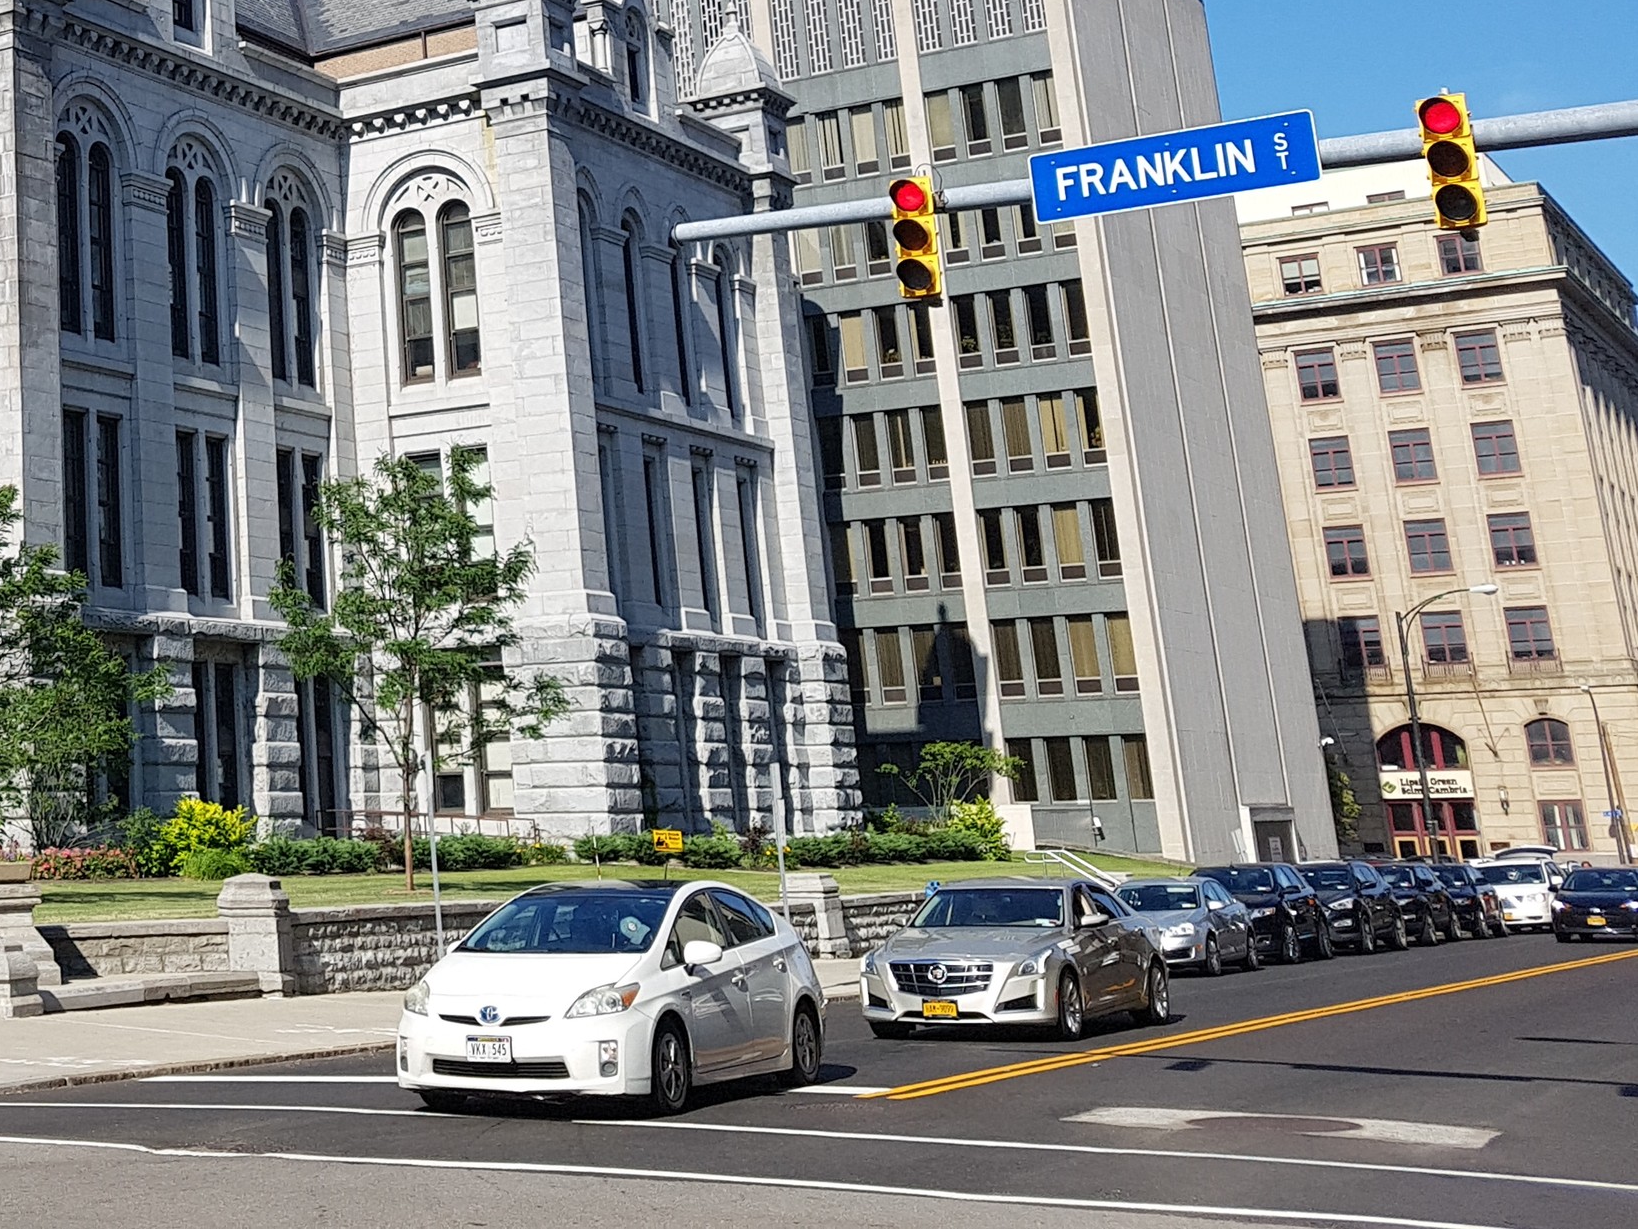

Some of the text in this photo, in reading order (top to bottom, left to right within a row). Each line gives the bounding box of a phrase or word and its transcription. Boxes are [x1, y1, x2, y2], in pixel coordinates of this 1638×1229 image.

[1055, 132, 1290, 201] FRANKLIN ST
[492, 1043, 507, 1056] 545
